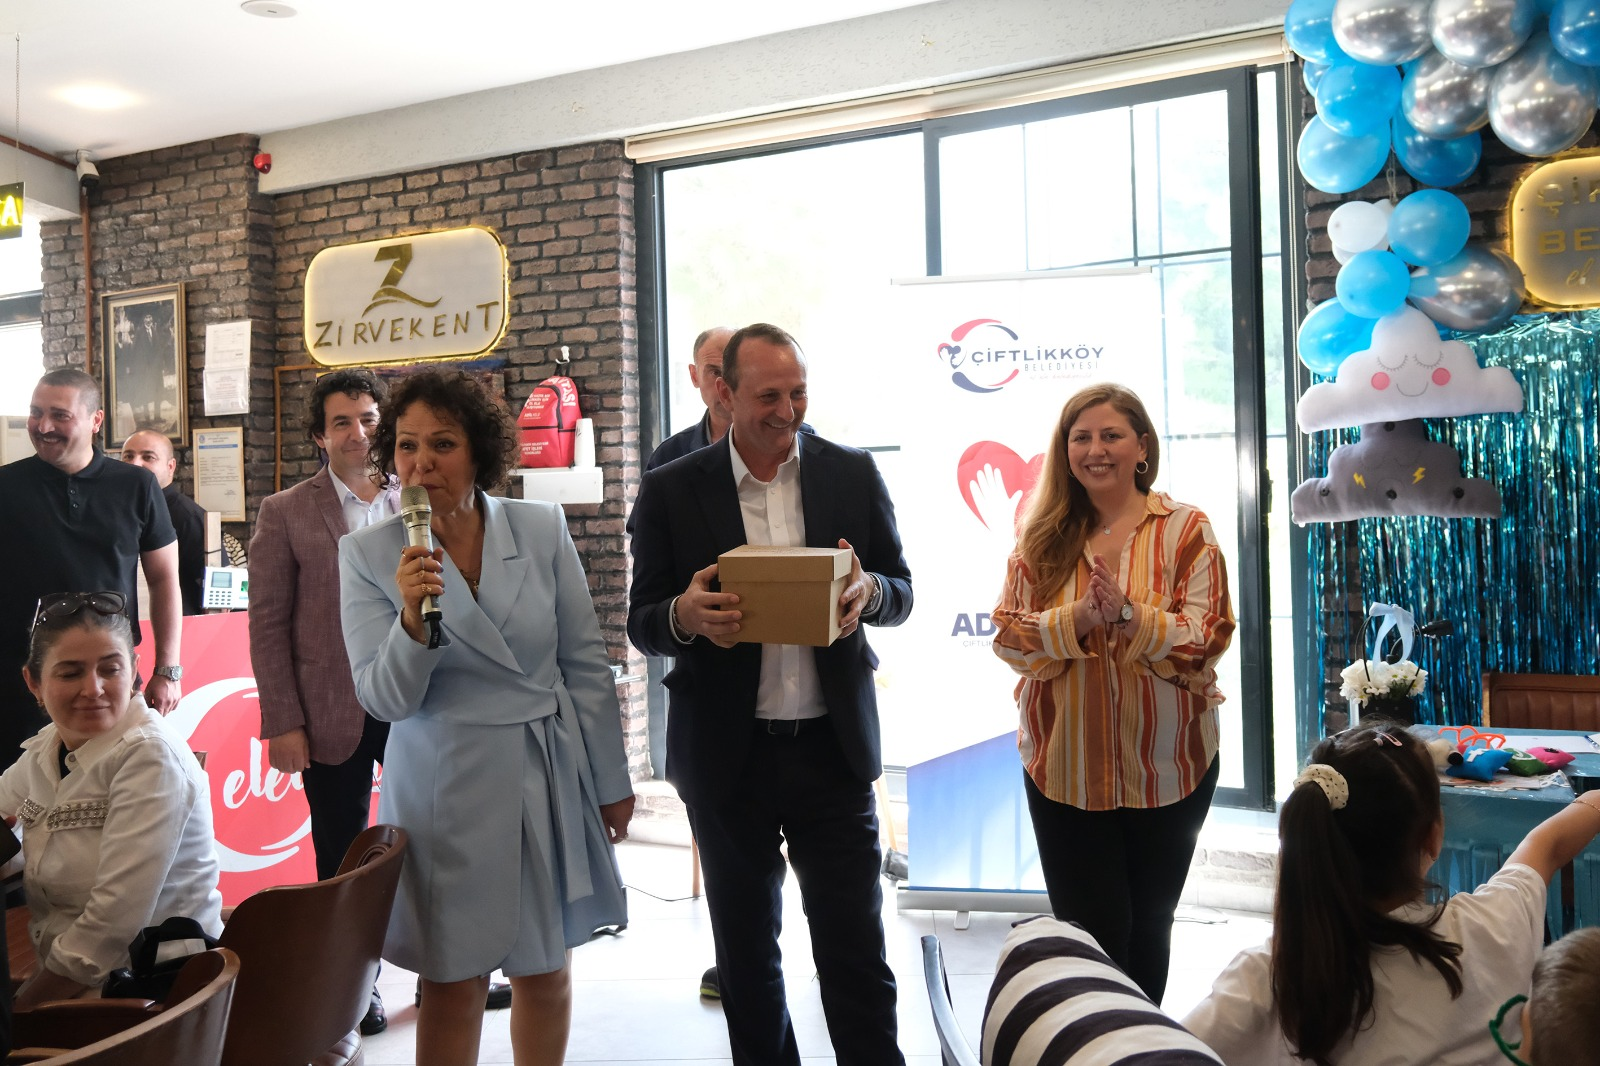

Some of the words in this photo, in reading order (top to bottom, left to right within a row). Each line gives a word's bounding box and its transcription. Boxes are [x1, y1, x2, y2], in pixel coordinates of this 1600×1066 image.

[972, 345, 1104, 366] ÇİFTLİKKÖY
[1024, 361, 1098, 371] BELEDİYESİ
[951, 613, 997, 636] AD
